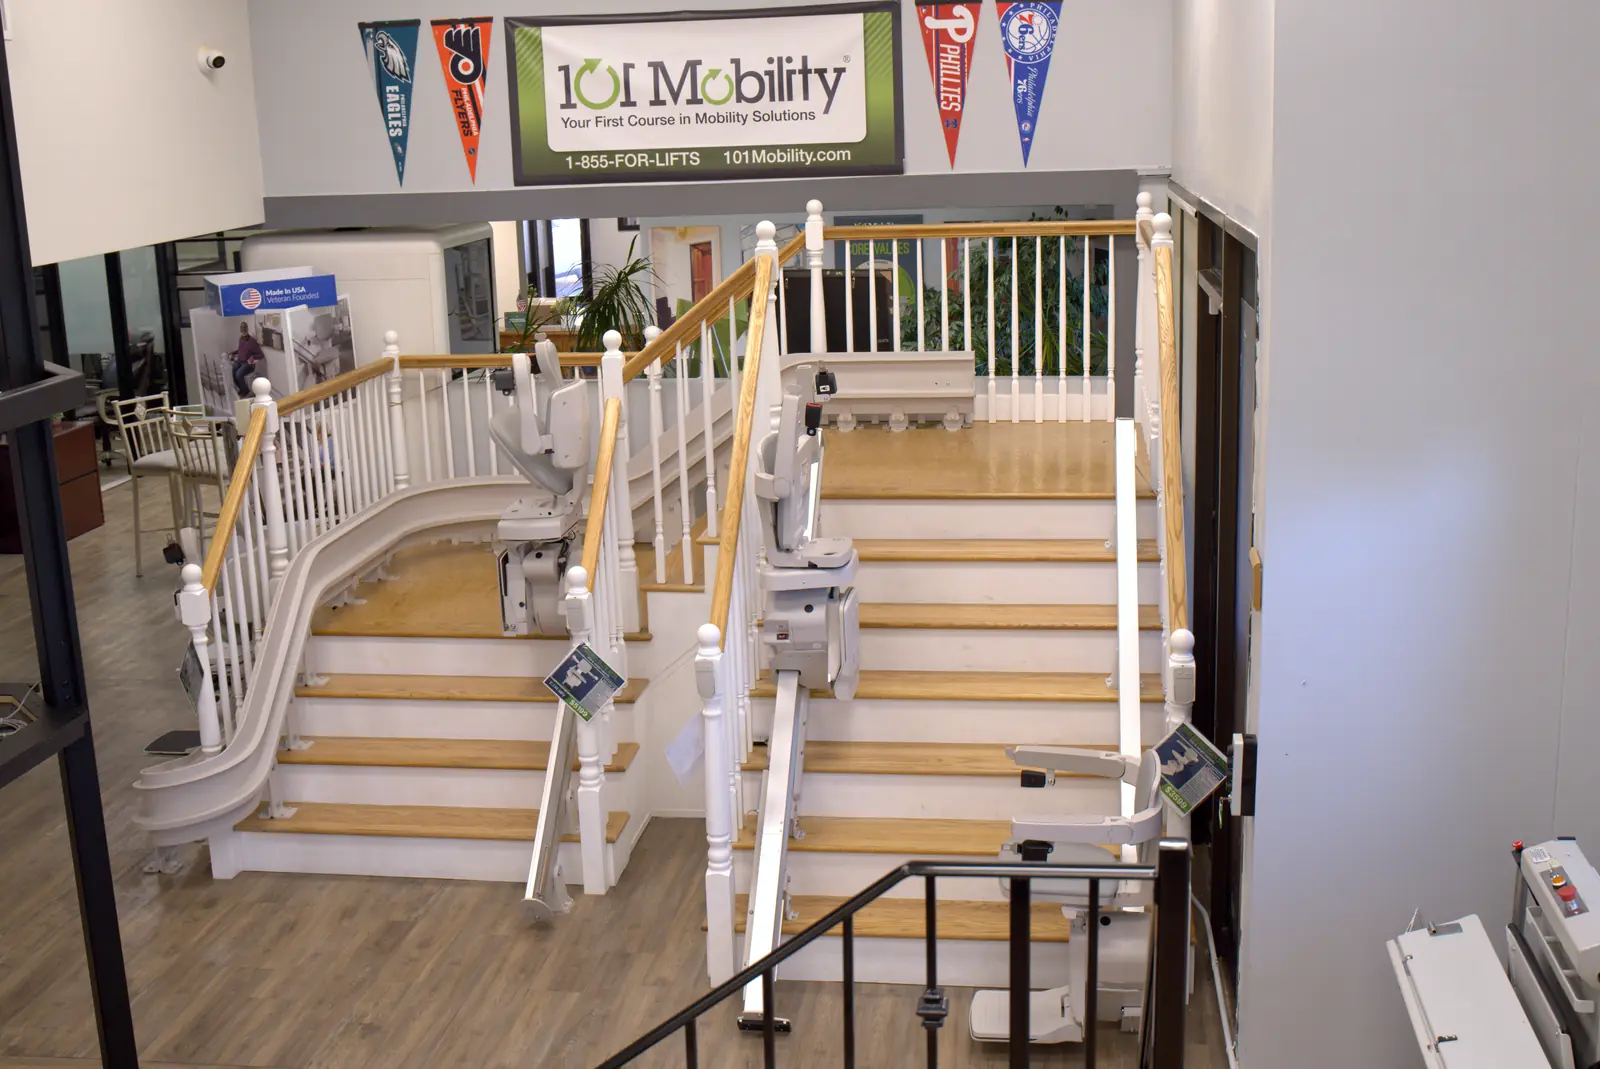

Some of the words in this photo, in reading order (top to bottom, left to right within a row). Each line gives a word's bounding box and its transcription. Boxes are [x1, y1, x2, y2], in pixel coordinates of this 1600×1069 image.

[1018, 13, 1034, 50] 76ers
[558, 58, 637, 110] 101
[648, 55, 846, 114] Mobility
[940, 43, 961, 112] PHILLIES
[1017, 79, 1027, 104] 76ers
[1027, 66, 1039, 118] Philadelphia
[386, 85, 402, 137] EAGLES
[451, 88, 473, 136] FLYERS
[461, 87, 478, 136] PHILADELPHIA
[561, 117, 591, 129] Your
[595, 115, 625, 128] First
[628, 114, 676, 127] Course
[679, 113, 691, 125] in
[695, 110, 748, 126] Mobility
[752, 109, 816, 123] Solutions
[565, 151, 701, 170] 1-855-FOR-LIFTS
[723, 149, 851, 165] 101Mobility.com
[849, 242, 870, 256] ORE
[874, 241, 910, 255] VALES
[266, 294, 291, 304] Veteran
[292, 292, 319, 301] Founded
[291, 286, 306, 294] USA
